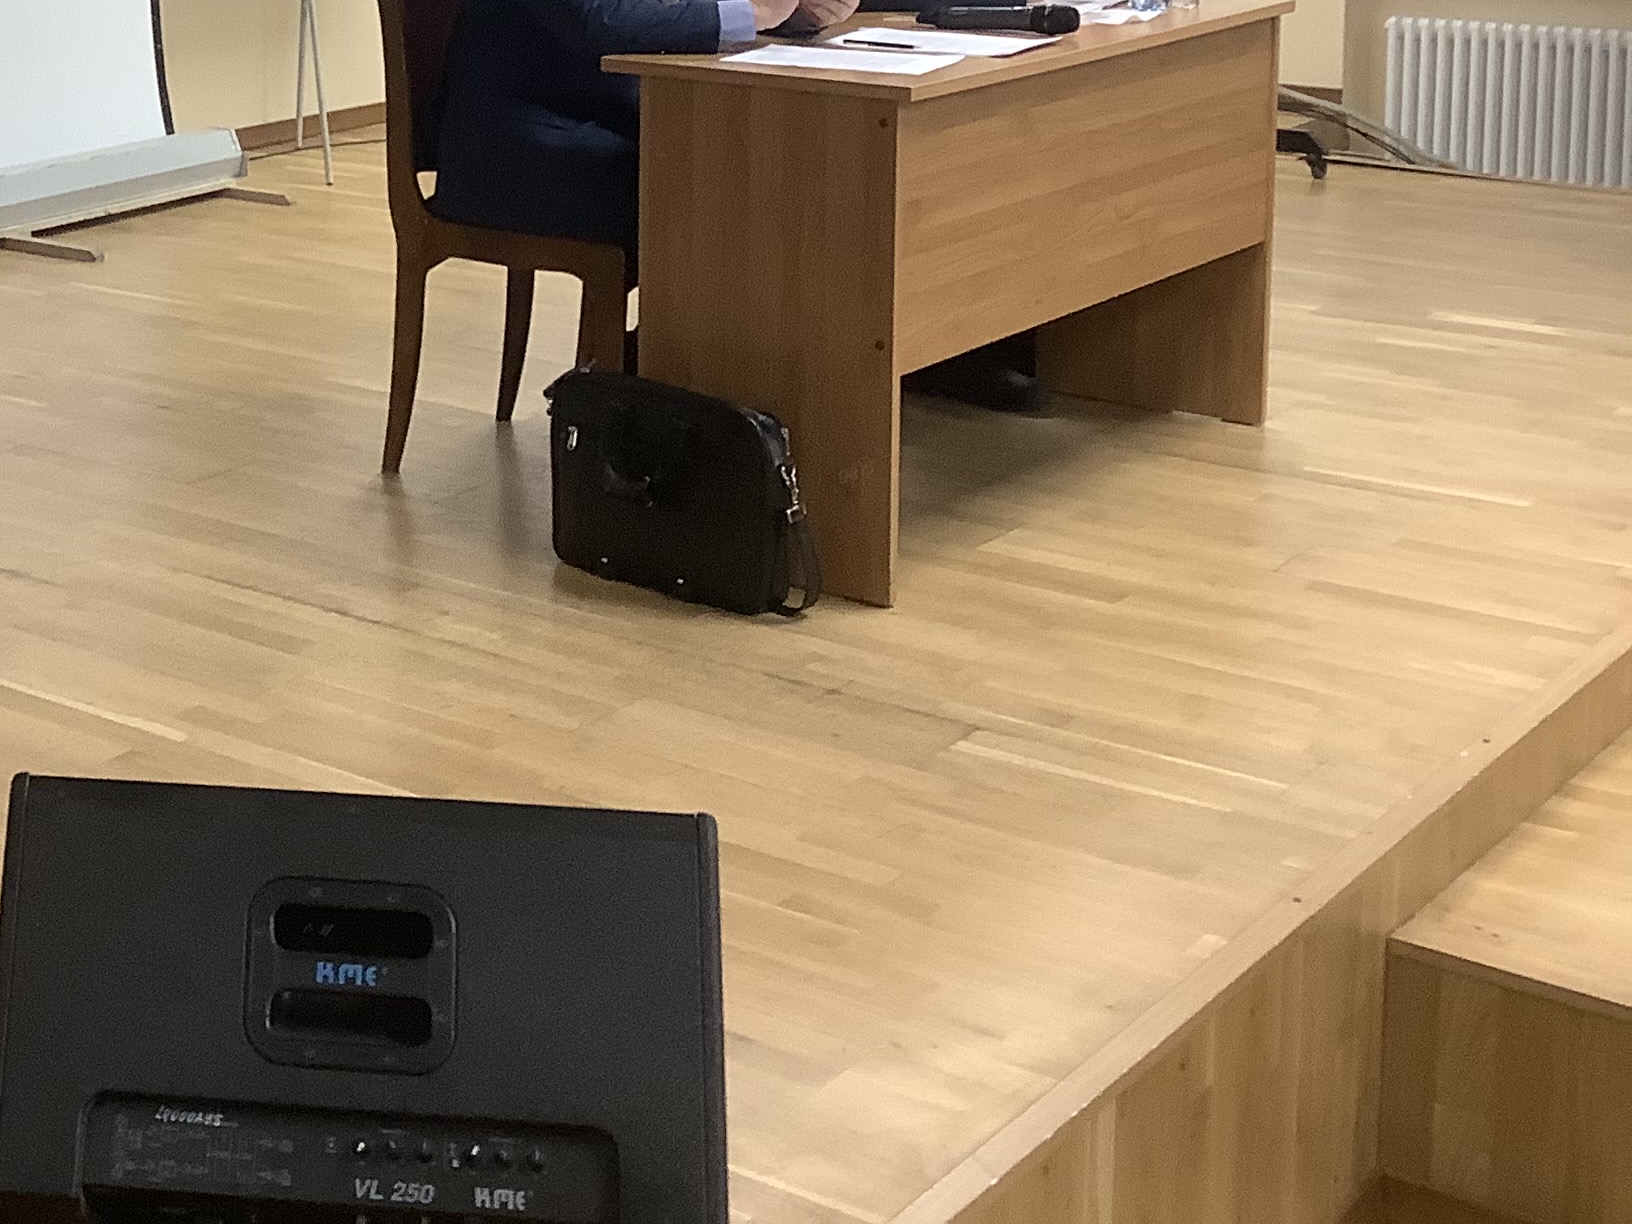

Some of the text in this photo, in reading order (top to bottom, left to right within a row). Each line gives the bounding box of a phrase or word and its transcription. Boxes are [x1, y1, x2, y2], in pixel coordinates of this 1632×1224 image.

[316, 961, 378, 987] KME
[355, 1178, 435, 1204] VL 250
[474, 1187, 527, 1211] KME
